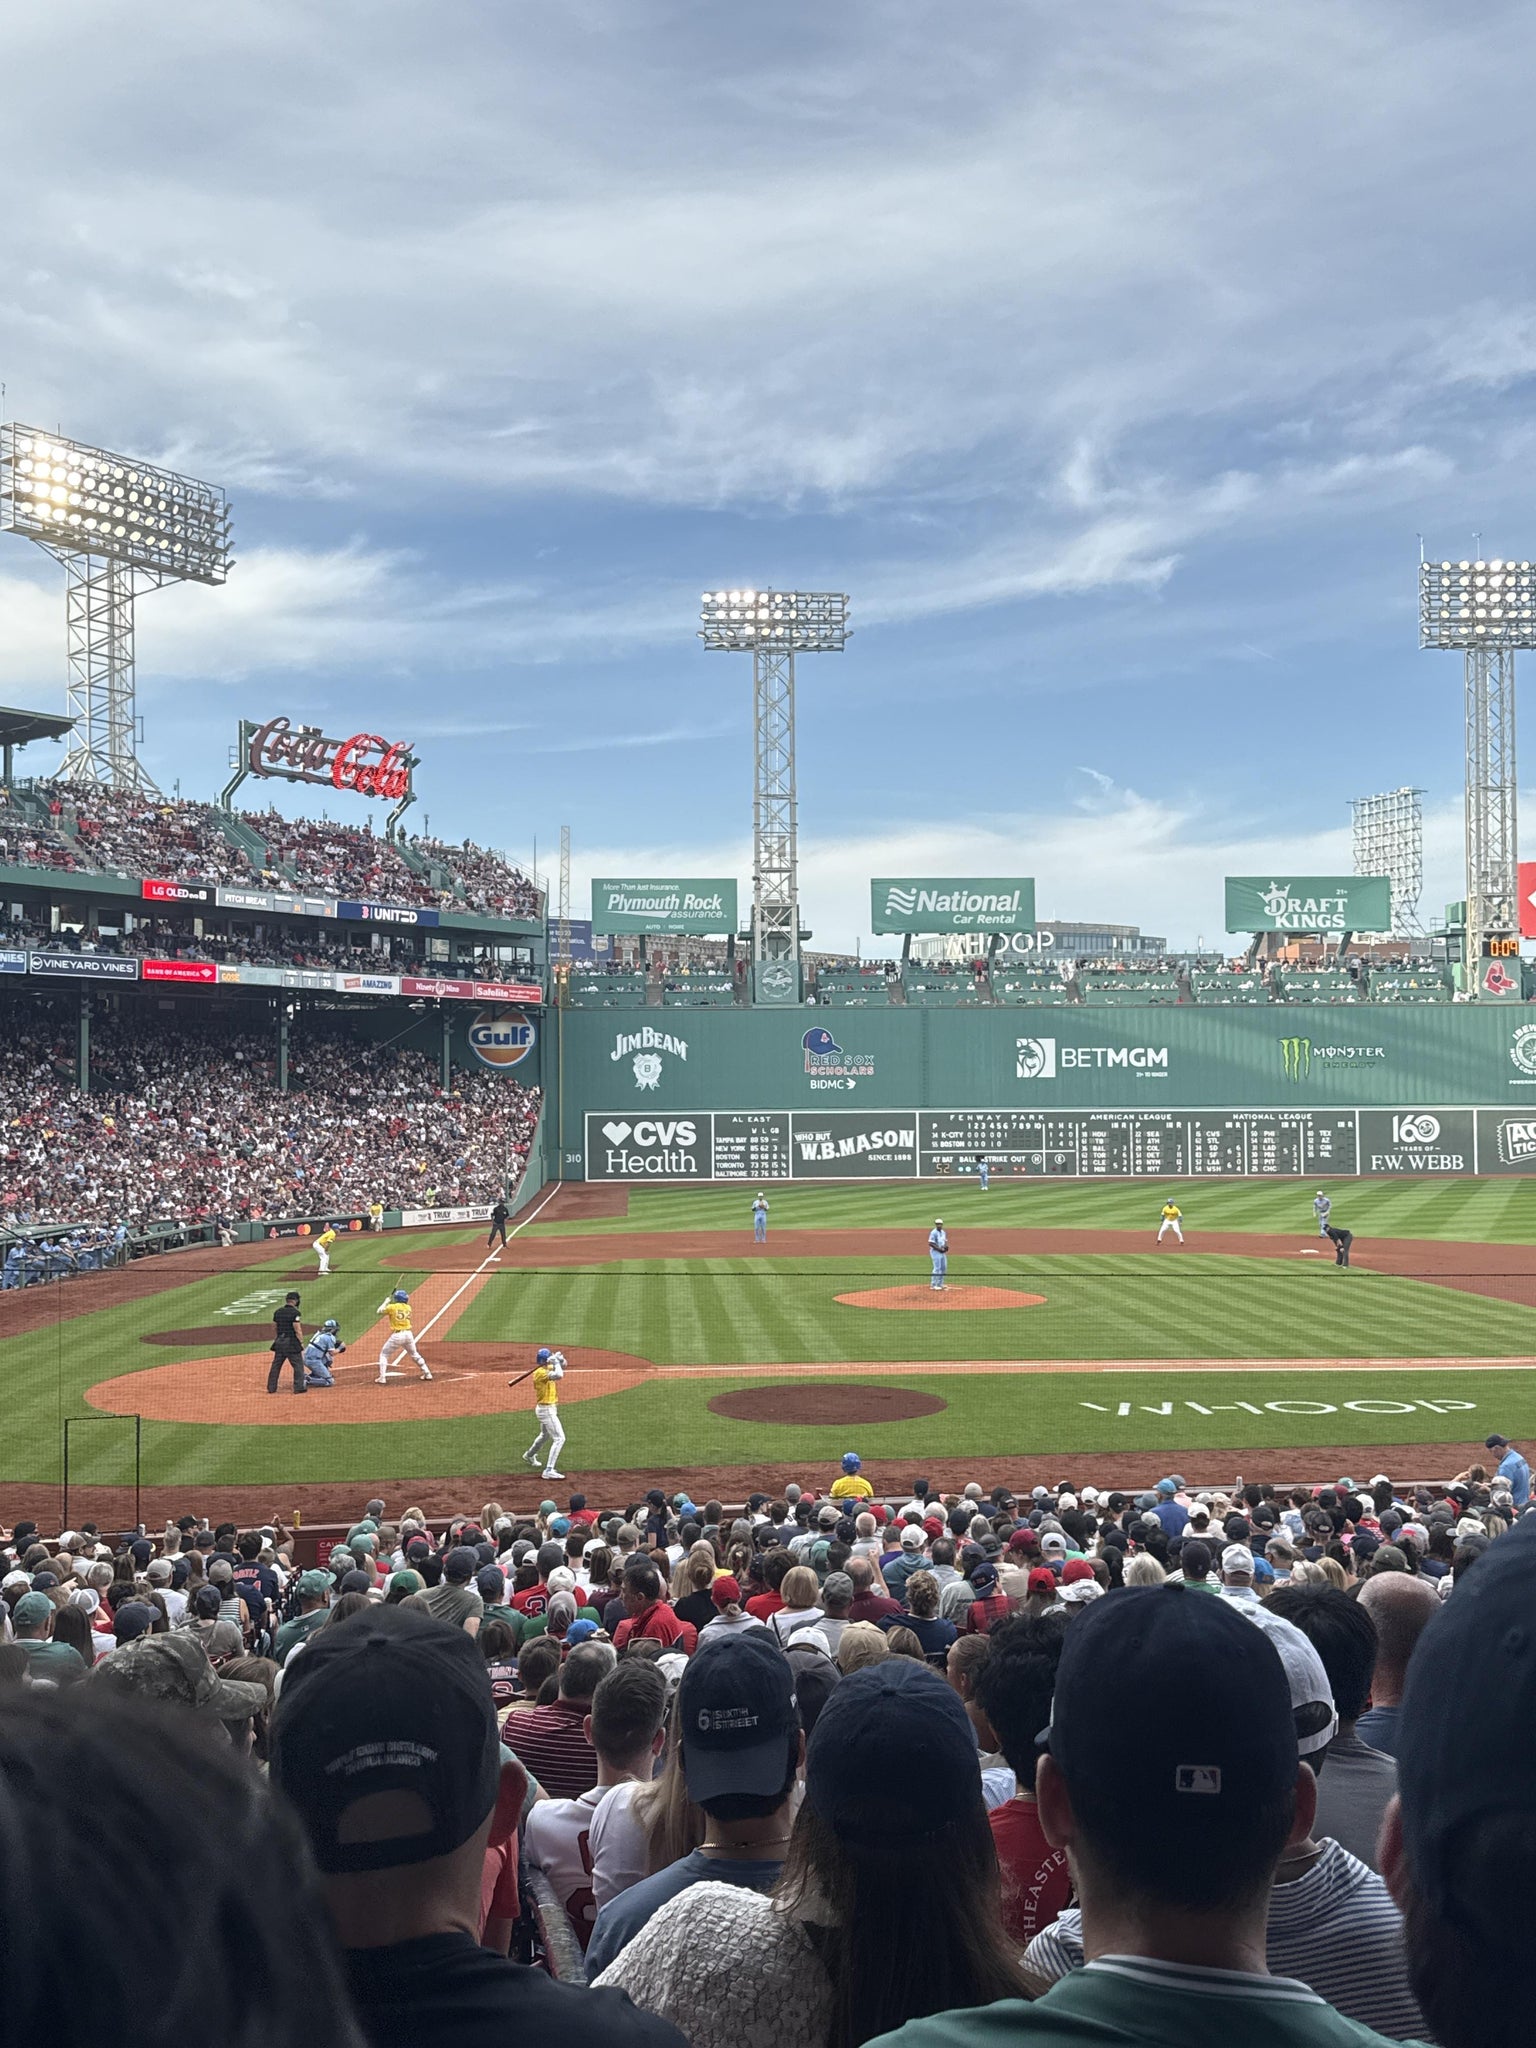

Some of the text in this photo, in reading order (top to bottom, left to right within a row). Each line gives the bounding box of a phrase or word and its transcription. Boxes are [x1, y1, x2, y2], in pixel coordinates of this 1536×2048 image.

[153, 886, 164, 896] LG
[166, 888, 188, 898] OLED
[620, 883, 636, 891] Than
[636, 883, 649, 891] Just
[608, 893, 722, 912] Plymouth Rock
[1264, 896, 1348, 917] DRAFT
[374, 907, 418, 923] UNITED
[671, 911, 723, 919] assurance
[953, 914, 1016, 924] Car Rental
[1275, 912, 1346, 928] KINGS
[947, 931, 1055, 956] WHOOP
[1491, 941, 1518, 957] 0:09
[43, 959, 134, 973] VINEYARD VINES
[416, 983, 435, 993] Ninety
[446, 985, 460, 993] Nine
[477, 987, 509, 998] Safelite
[471, 1026, 530, 1045] Gulf
[610, 1026, 689, 1061] JIM BEAM
[810, 1055, 874, 1065] RED SOX
[1062, 1048, 1168, 1067] BETMGM
[810, 1066, 874, 1075] SCHOLARS
[810, 1080, 844, 1089] BIDMC
[633, 1121, 697, 1146] CVS
[1392, 1114, 1440, 1143] 160
[794, 1133, 831, 1141] WHO BUT
[565, 1154, 582, 1163] 310
[606, 1149, 698, 1173] Health
[1371, 1155, 1464, 1170] F.W. WEBB
[936, 1164, 950, 1174] 52
[433, 1211, 451, 1219] TRULY
[472, 1208, 489, 1216] TRULY
[1078, 1400, 1477, 1416] WHOOP
[698, 1708, 710, 1731] 6
[715, 1708, 749, 1719] SIXTH
[715, 1716, 759, 1730] STREET
